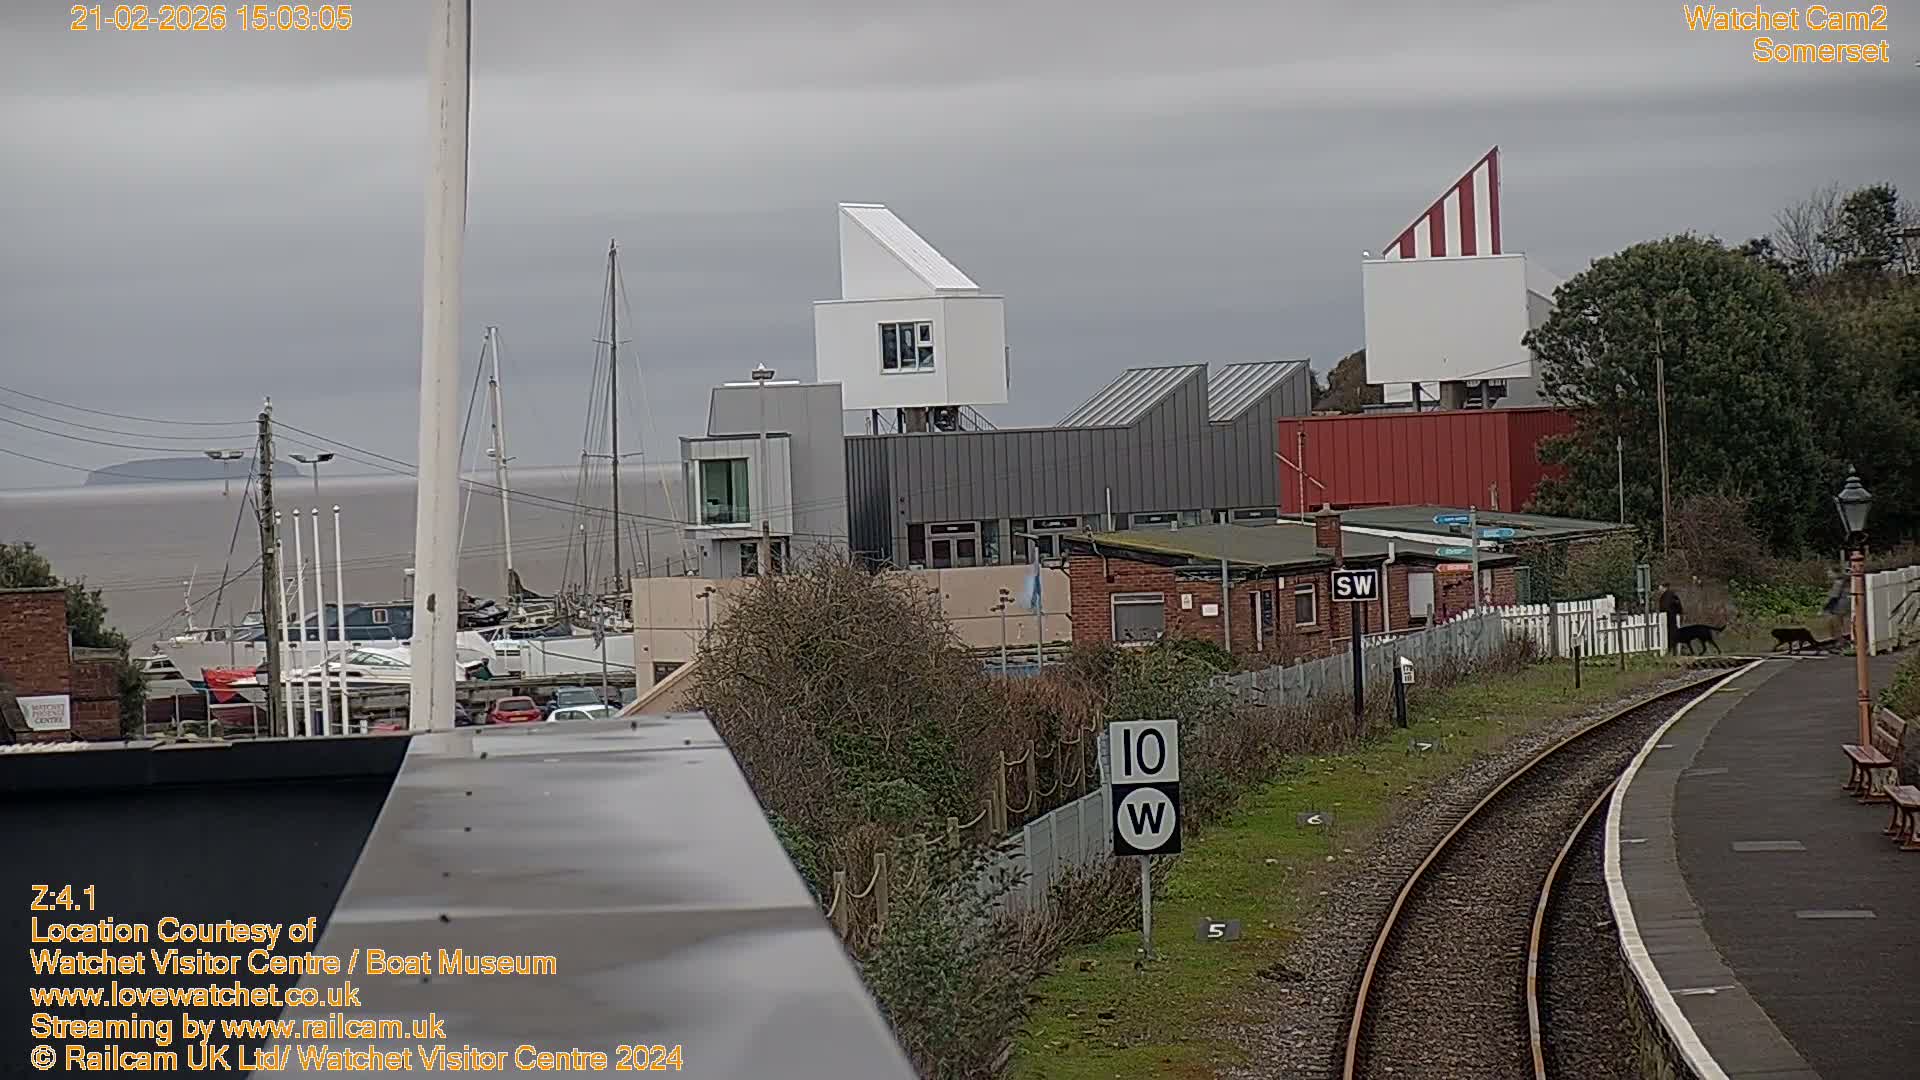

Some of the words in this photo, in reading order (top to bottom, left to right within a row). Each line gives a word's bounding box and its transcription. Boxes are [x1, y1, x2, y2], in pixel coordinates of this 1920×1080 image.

[1337, 575, 1372, 595] SW
[1123, 728, 1165, 776] 10
[1127, 802, 1165, 834] W
[1208, 924, 1226, 938] 5
